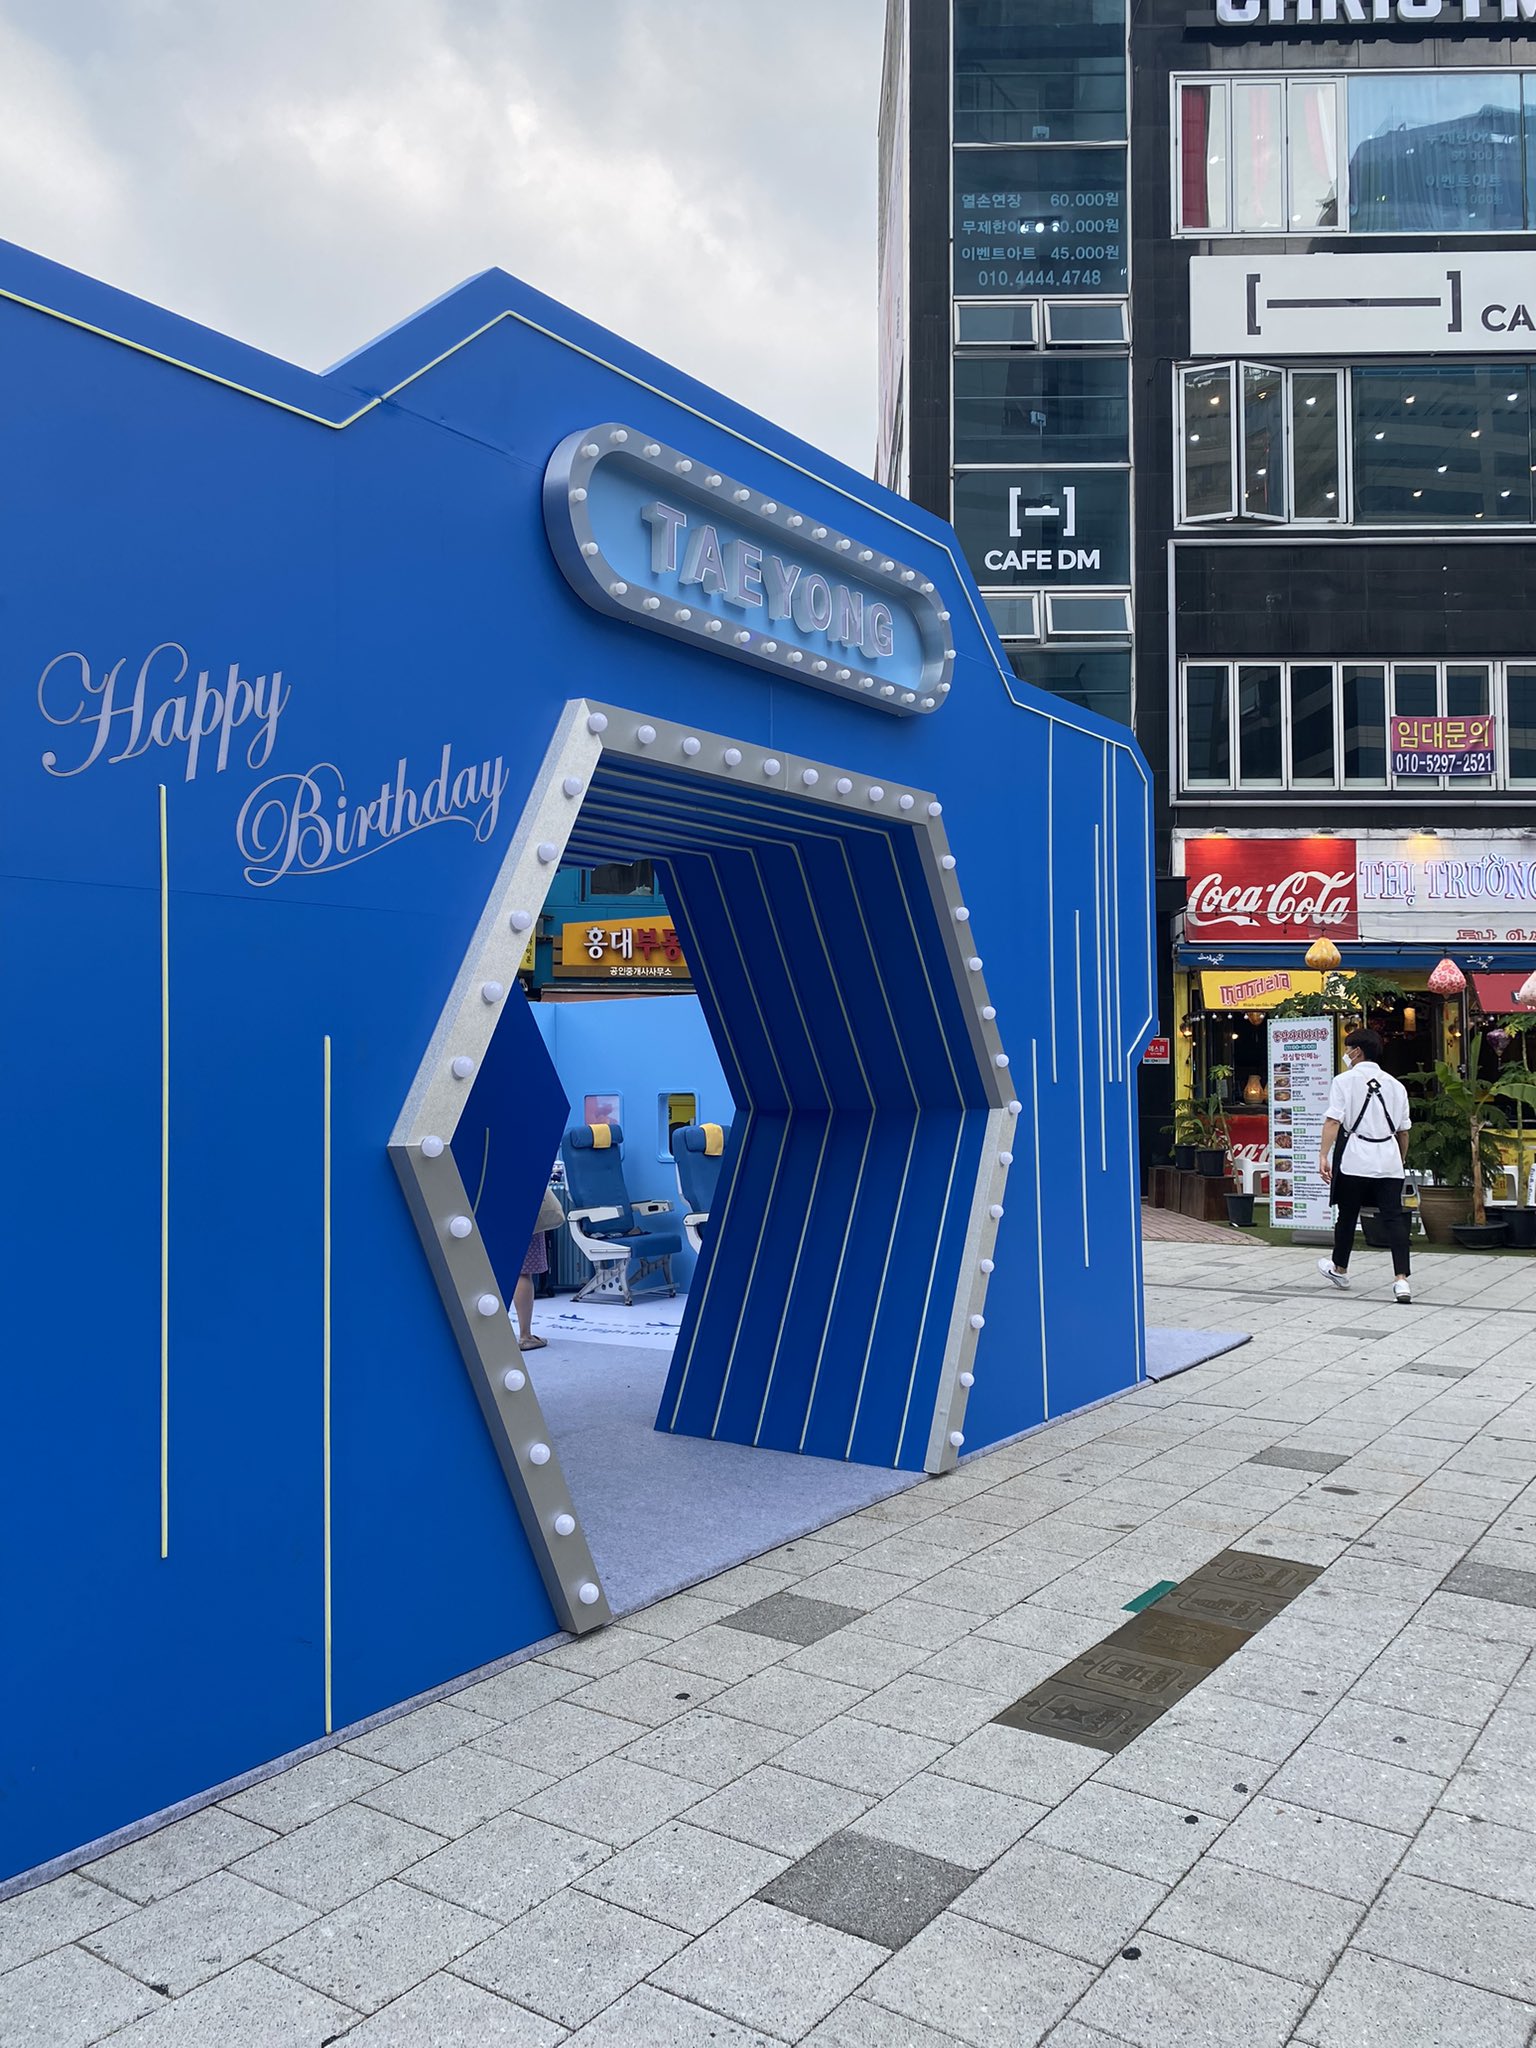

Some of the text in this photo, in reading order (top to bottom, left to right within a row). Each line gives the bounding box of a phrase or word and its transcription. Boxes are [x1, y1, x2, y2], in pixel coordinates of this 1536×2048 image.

[1050, 192, 1119, 207] 60.000원
[961, 245, 1119, 261] 이벤트아트 45.000원
[978, 269, 1101, 287] 010.4444.4748
[984, 549, 1100, 571] CAFE DM
[641, 500, 895, 659] TAEYONG
[37, 641, 292, 782] Happy
[1397, 720, 1490, 749] 임대문의
[1396, 753, 1492, 773] 010-5297-2521
[235, 742, 510, 888] Birthday
[1186, 871, 1356, 927] Coca-Cola
[609, 966, 673, 977] 공인중개사사무소
